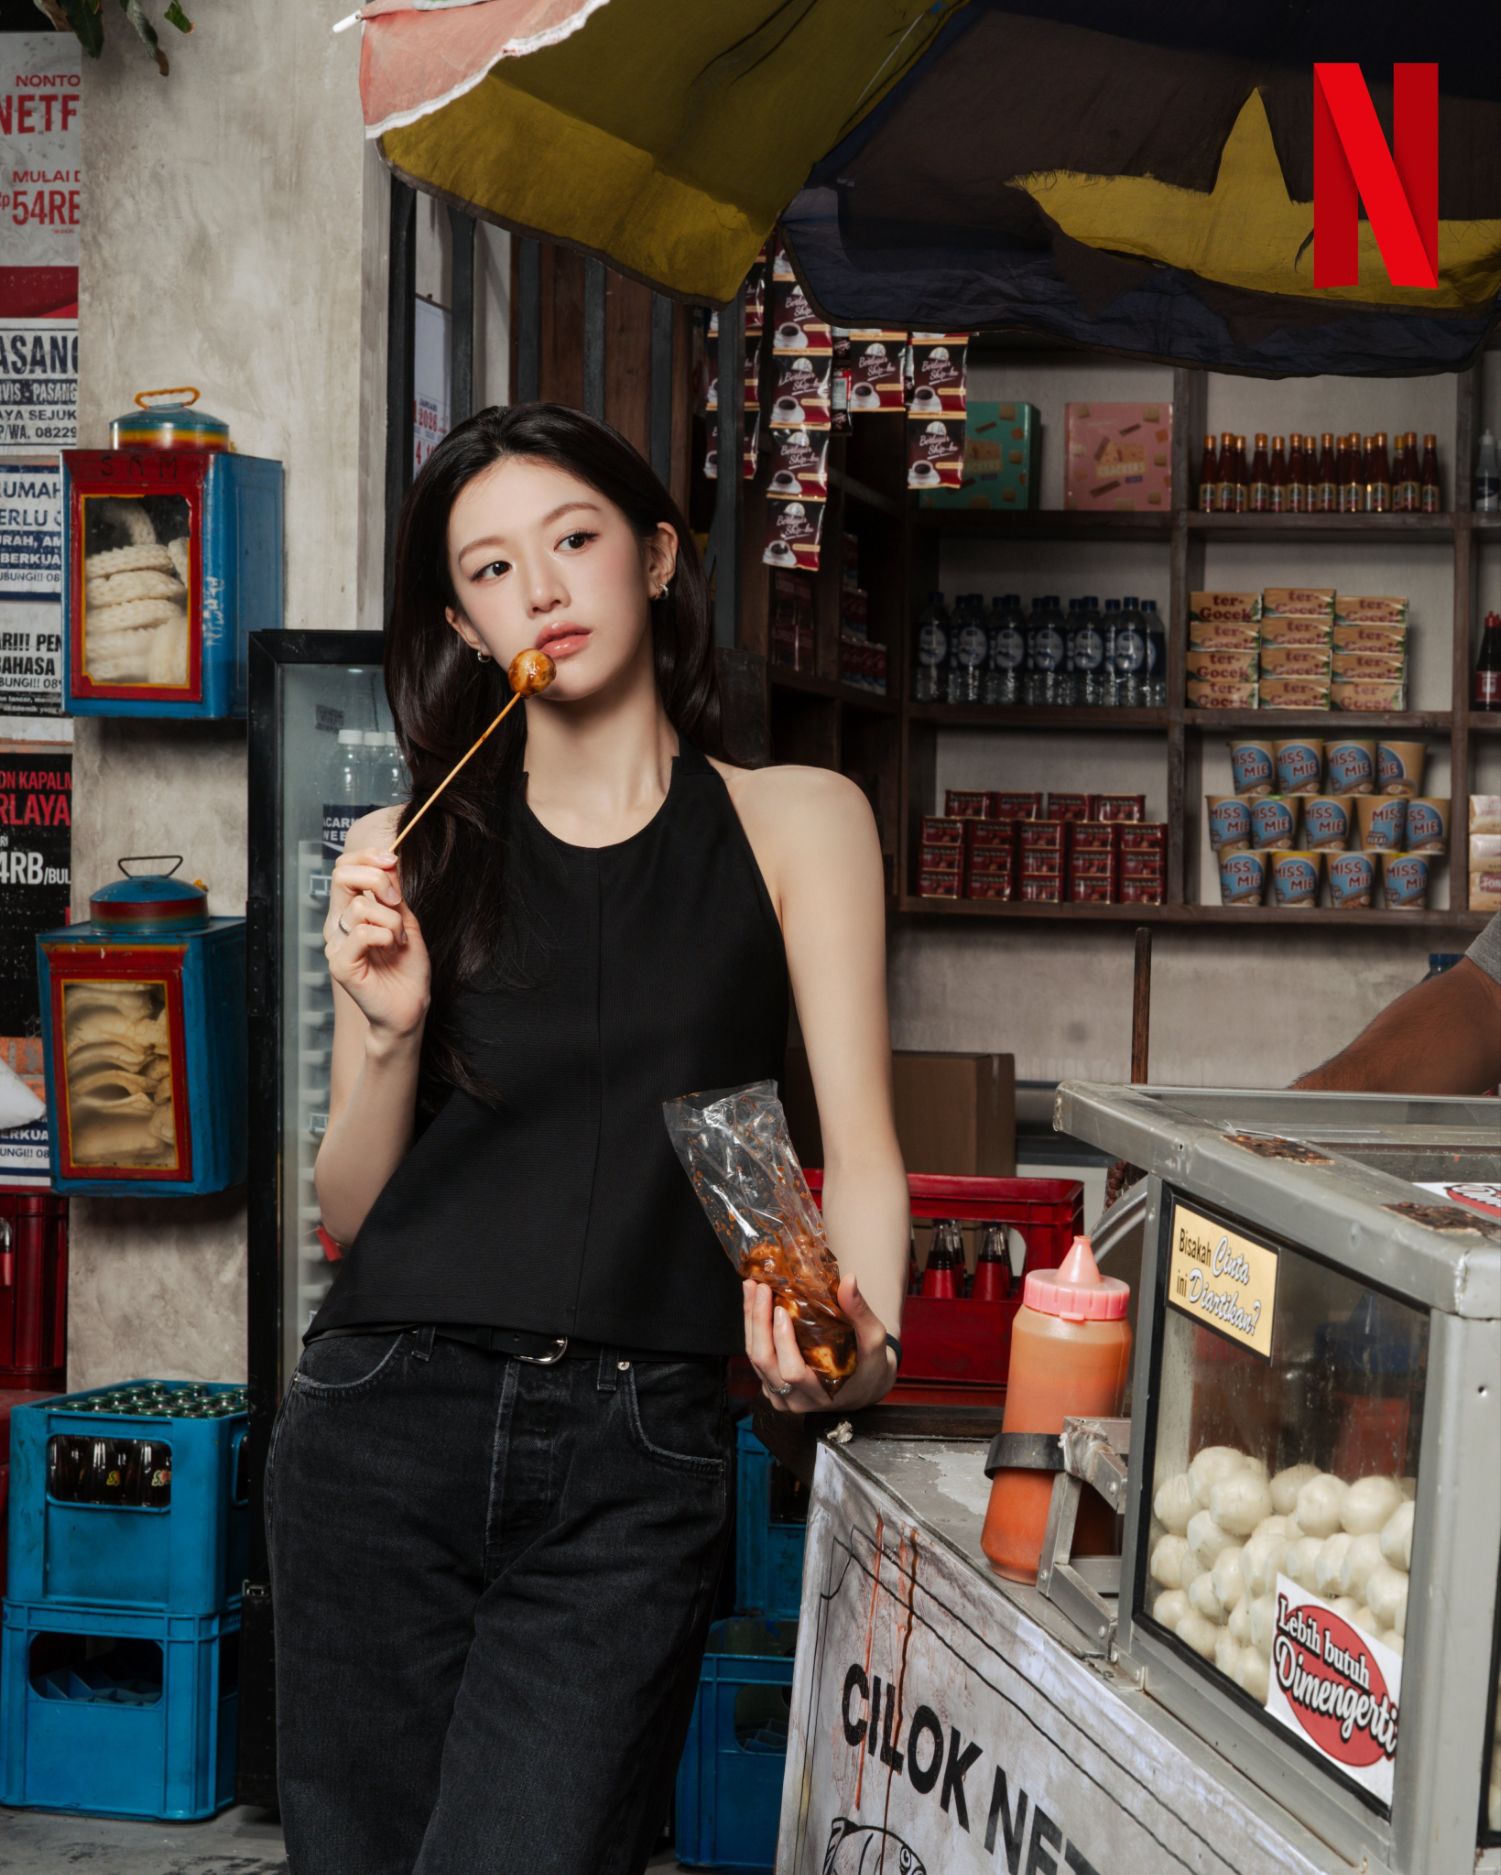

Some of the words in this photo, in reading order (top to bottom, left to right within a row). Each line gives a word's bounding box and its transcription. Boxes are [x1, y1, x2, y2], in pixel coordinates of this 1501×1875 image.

[13, 170, 70, 183] MULAI
[28, 409, 77, 421] SEJUK
[1200, 607, 1252, 620] Gocek
[1213, 595, 1244, 607] ter-
[1209, 653, 1240, 665] ter-
[1178, 1227, 1212, 1268] Bisakah
[1211, 1234, 1250, 1287] Cinta
[1176, 1268, 1188, 1298] ini
[1187, 1267, 1262, 1337] Diartikan?
[1278, 1593, 1321, 1657] Lebih
[1323, 1627, 1370, 1692] butuh
[1274, 1634, 1399, 1757] Dimengerti
[842, 1662, 984, 1835] CILOK
